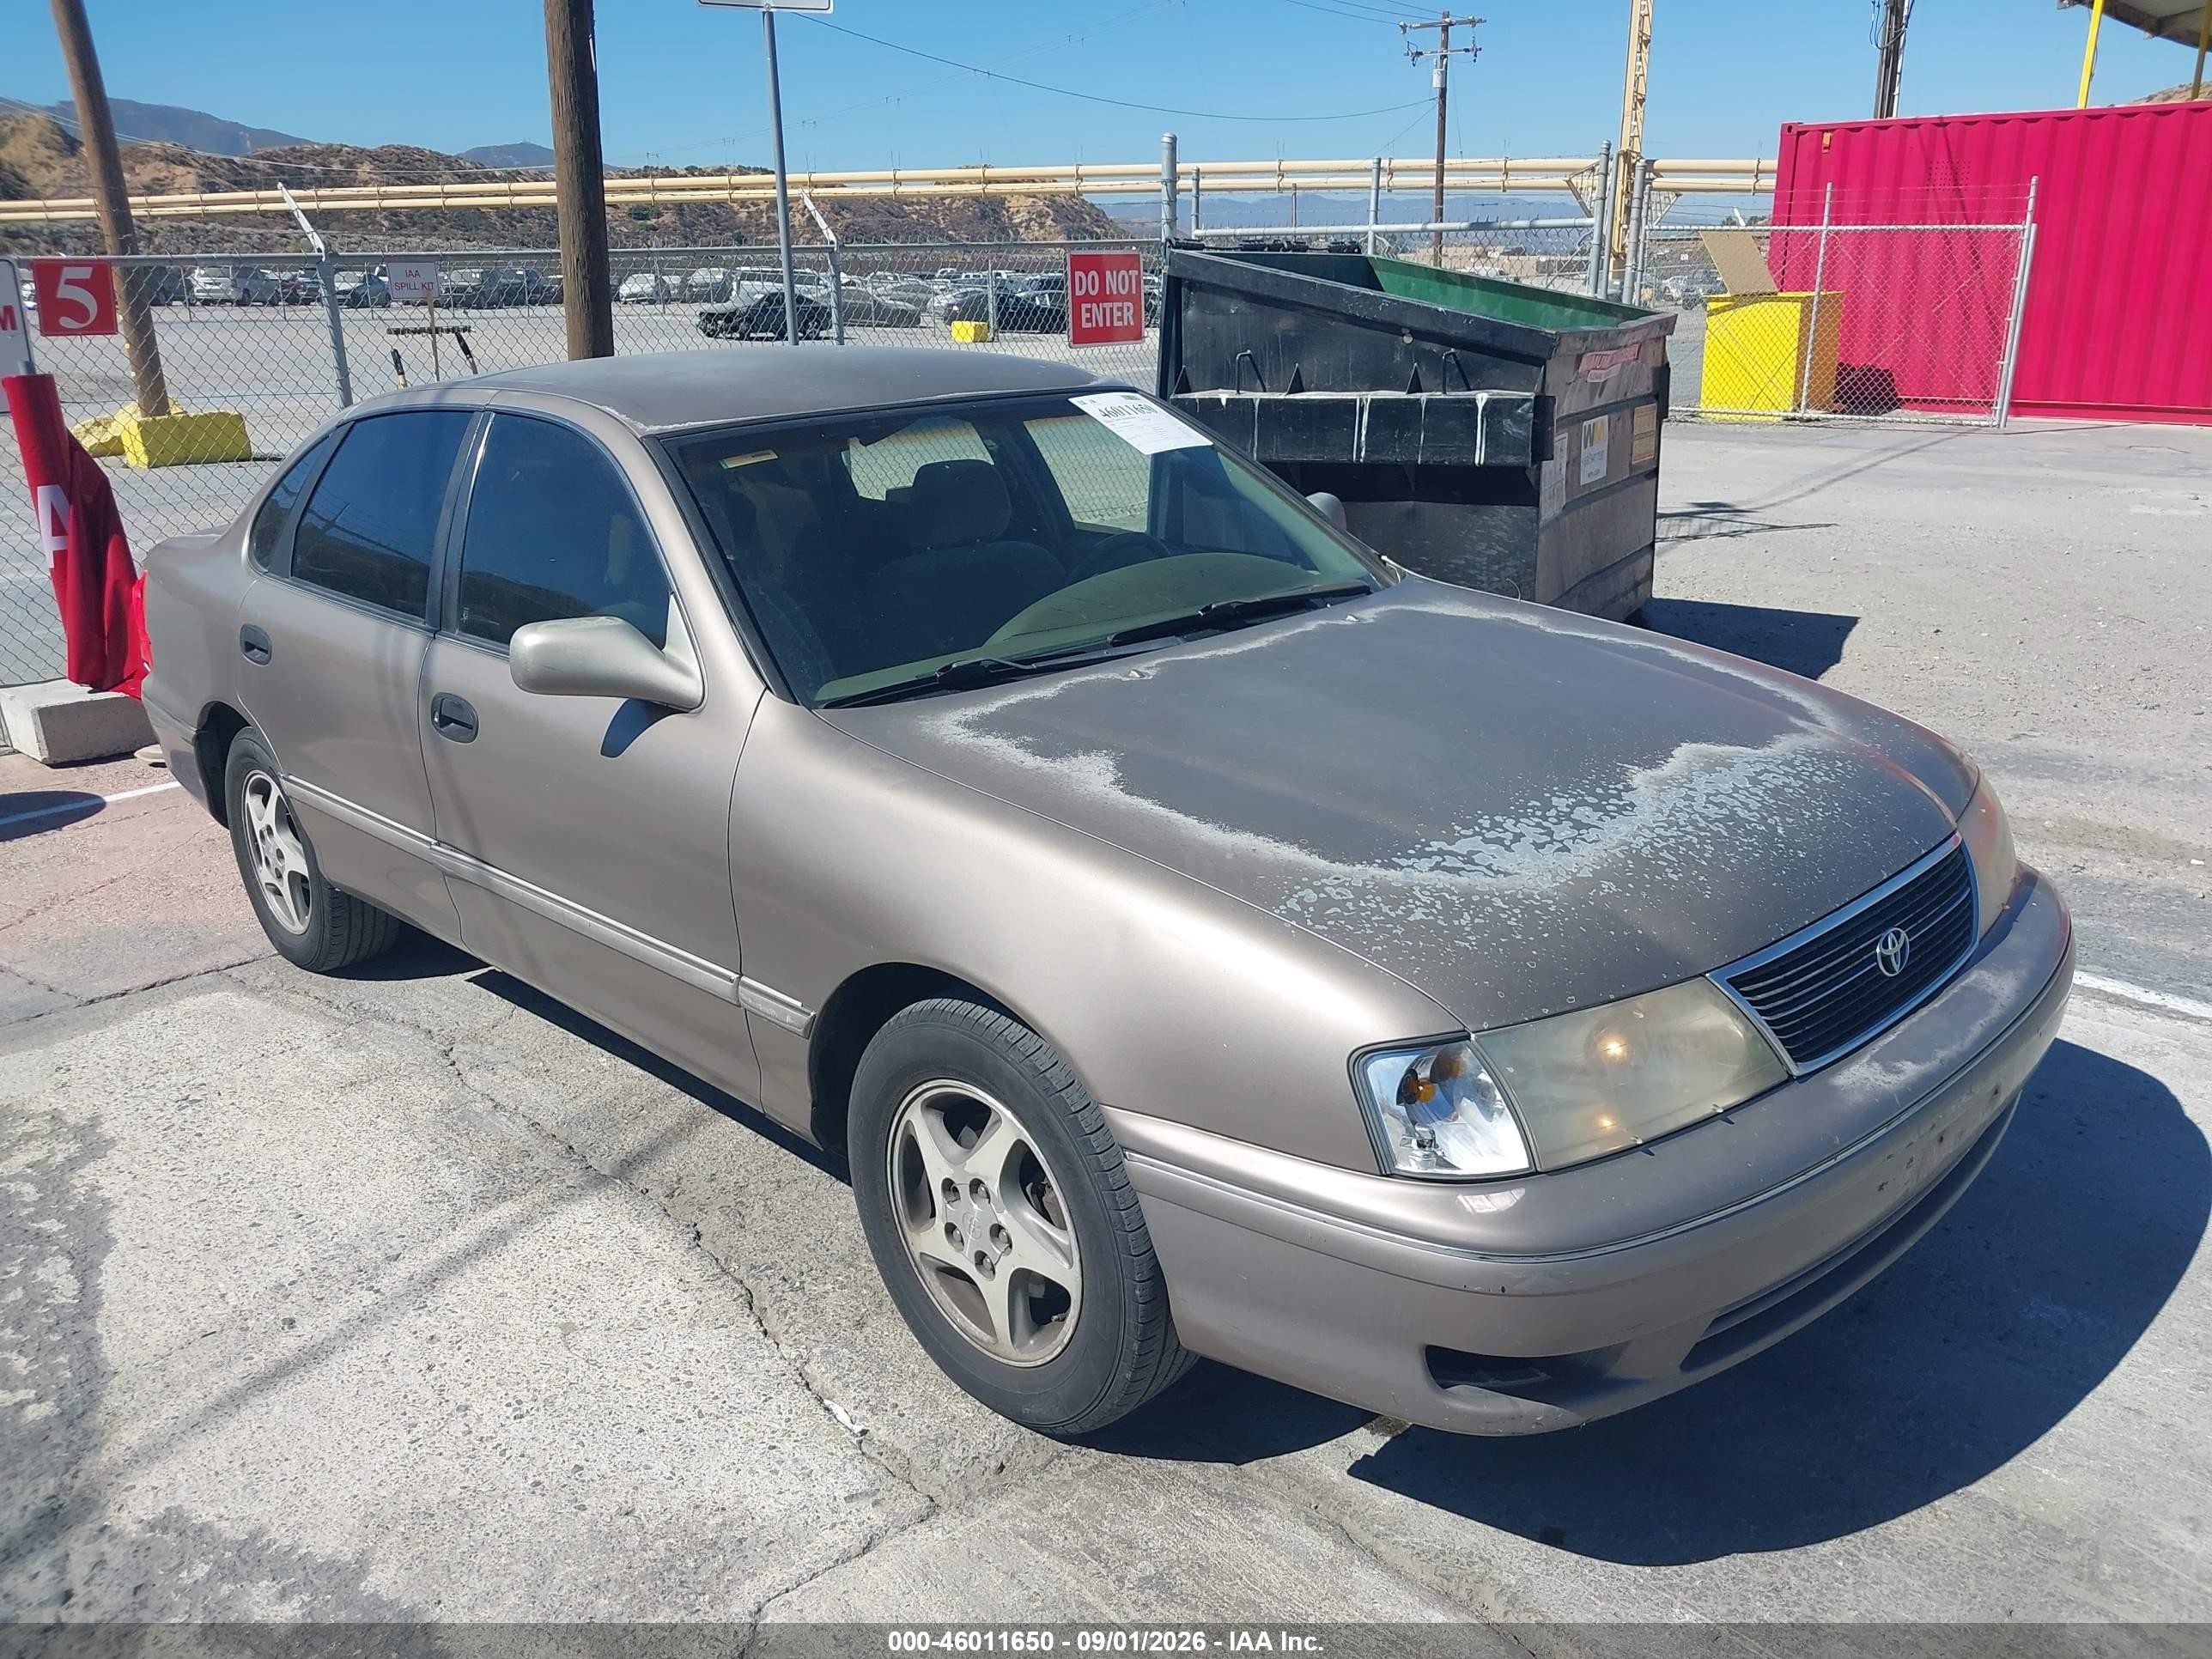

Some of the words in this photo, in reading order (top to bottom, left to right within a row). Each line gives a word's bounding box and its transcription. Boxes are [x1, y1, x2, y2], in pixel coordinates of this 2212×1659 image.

[394, 282, 419, 290] SPILL
[421, 282, 434, 290] KIT
[404, 269, 421, 278] IAA
[1074, 270, 1099, 296] DO
[1105, 270, 1139, 295] NOT
[56, 266, 98, 329] 5
[1080, 301, 1134, 329] ENTER
[1097, 404, 1158, 419] 46011650
[1583, 419, 1606, 449] WM
